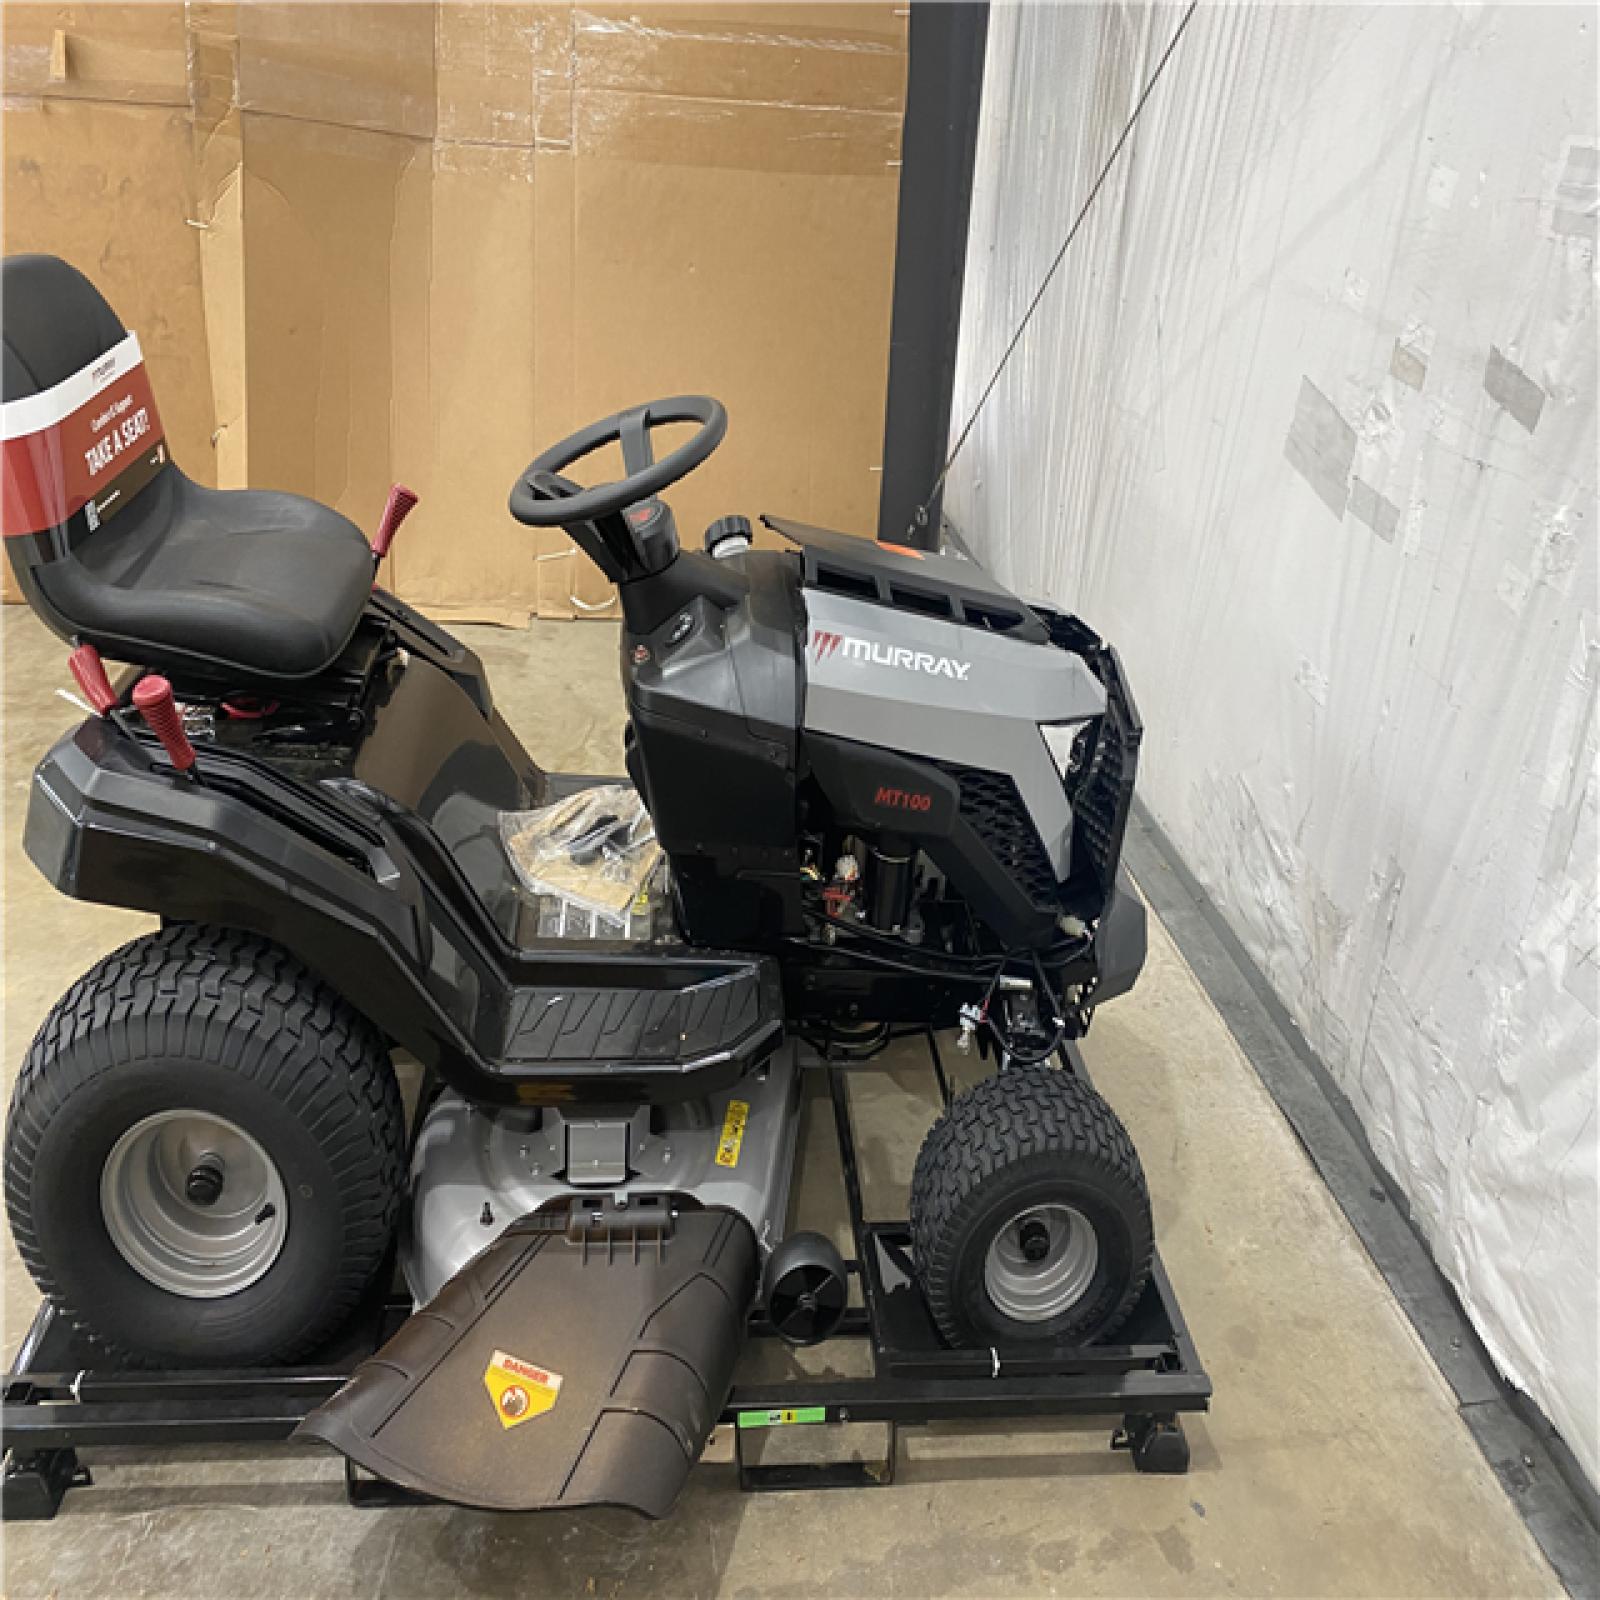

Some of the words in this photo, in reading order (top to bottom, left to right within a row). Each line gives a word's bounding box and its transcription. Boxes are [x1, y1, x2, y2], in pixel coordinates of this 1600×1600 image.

[85, 435, 113, 475] TAKE
[112, 429, 123, 455] A
[843, 636, 971, 681] MURRAY
[875, 786, 931, 811] MT100
